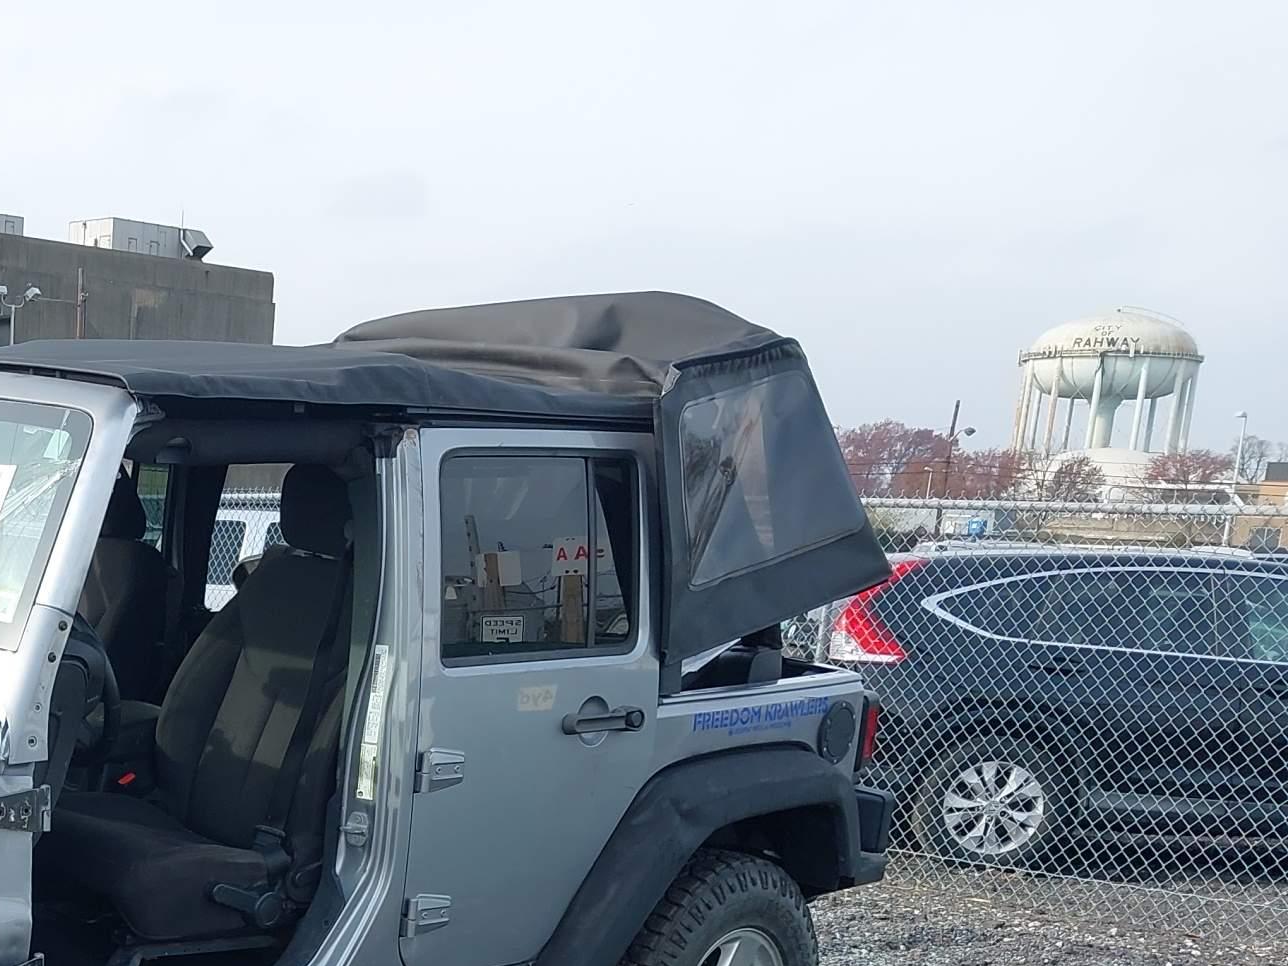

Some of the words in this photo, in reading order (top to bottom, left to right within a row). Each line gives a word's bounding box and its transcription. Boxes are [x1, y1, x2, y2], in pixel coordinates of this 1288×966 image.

[1072, 337, 1141, 348] RAHWAY
[692, 707, 762, 733] FREEDOM
[764, 697, 829, 722] KRAWLERS
